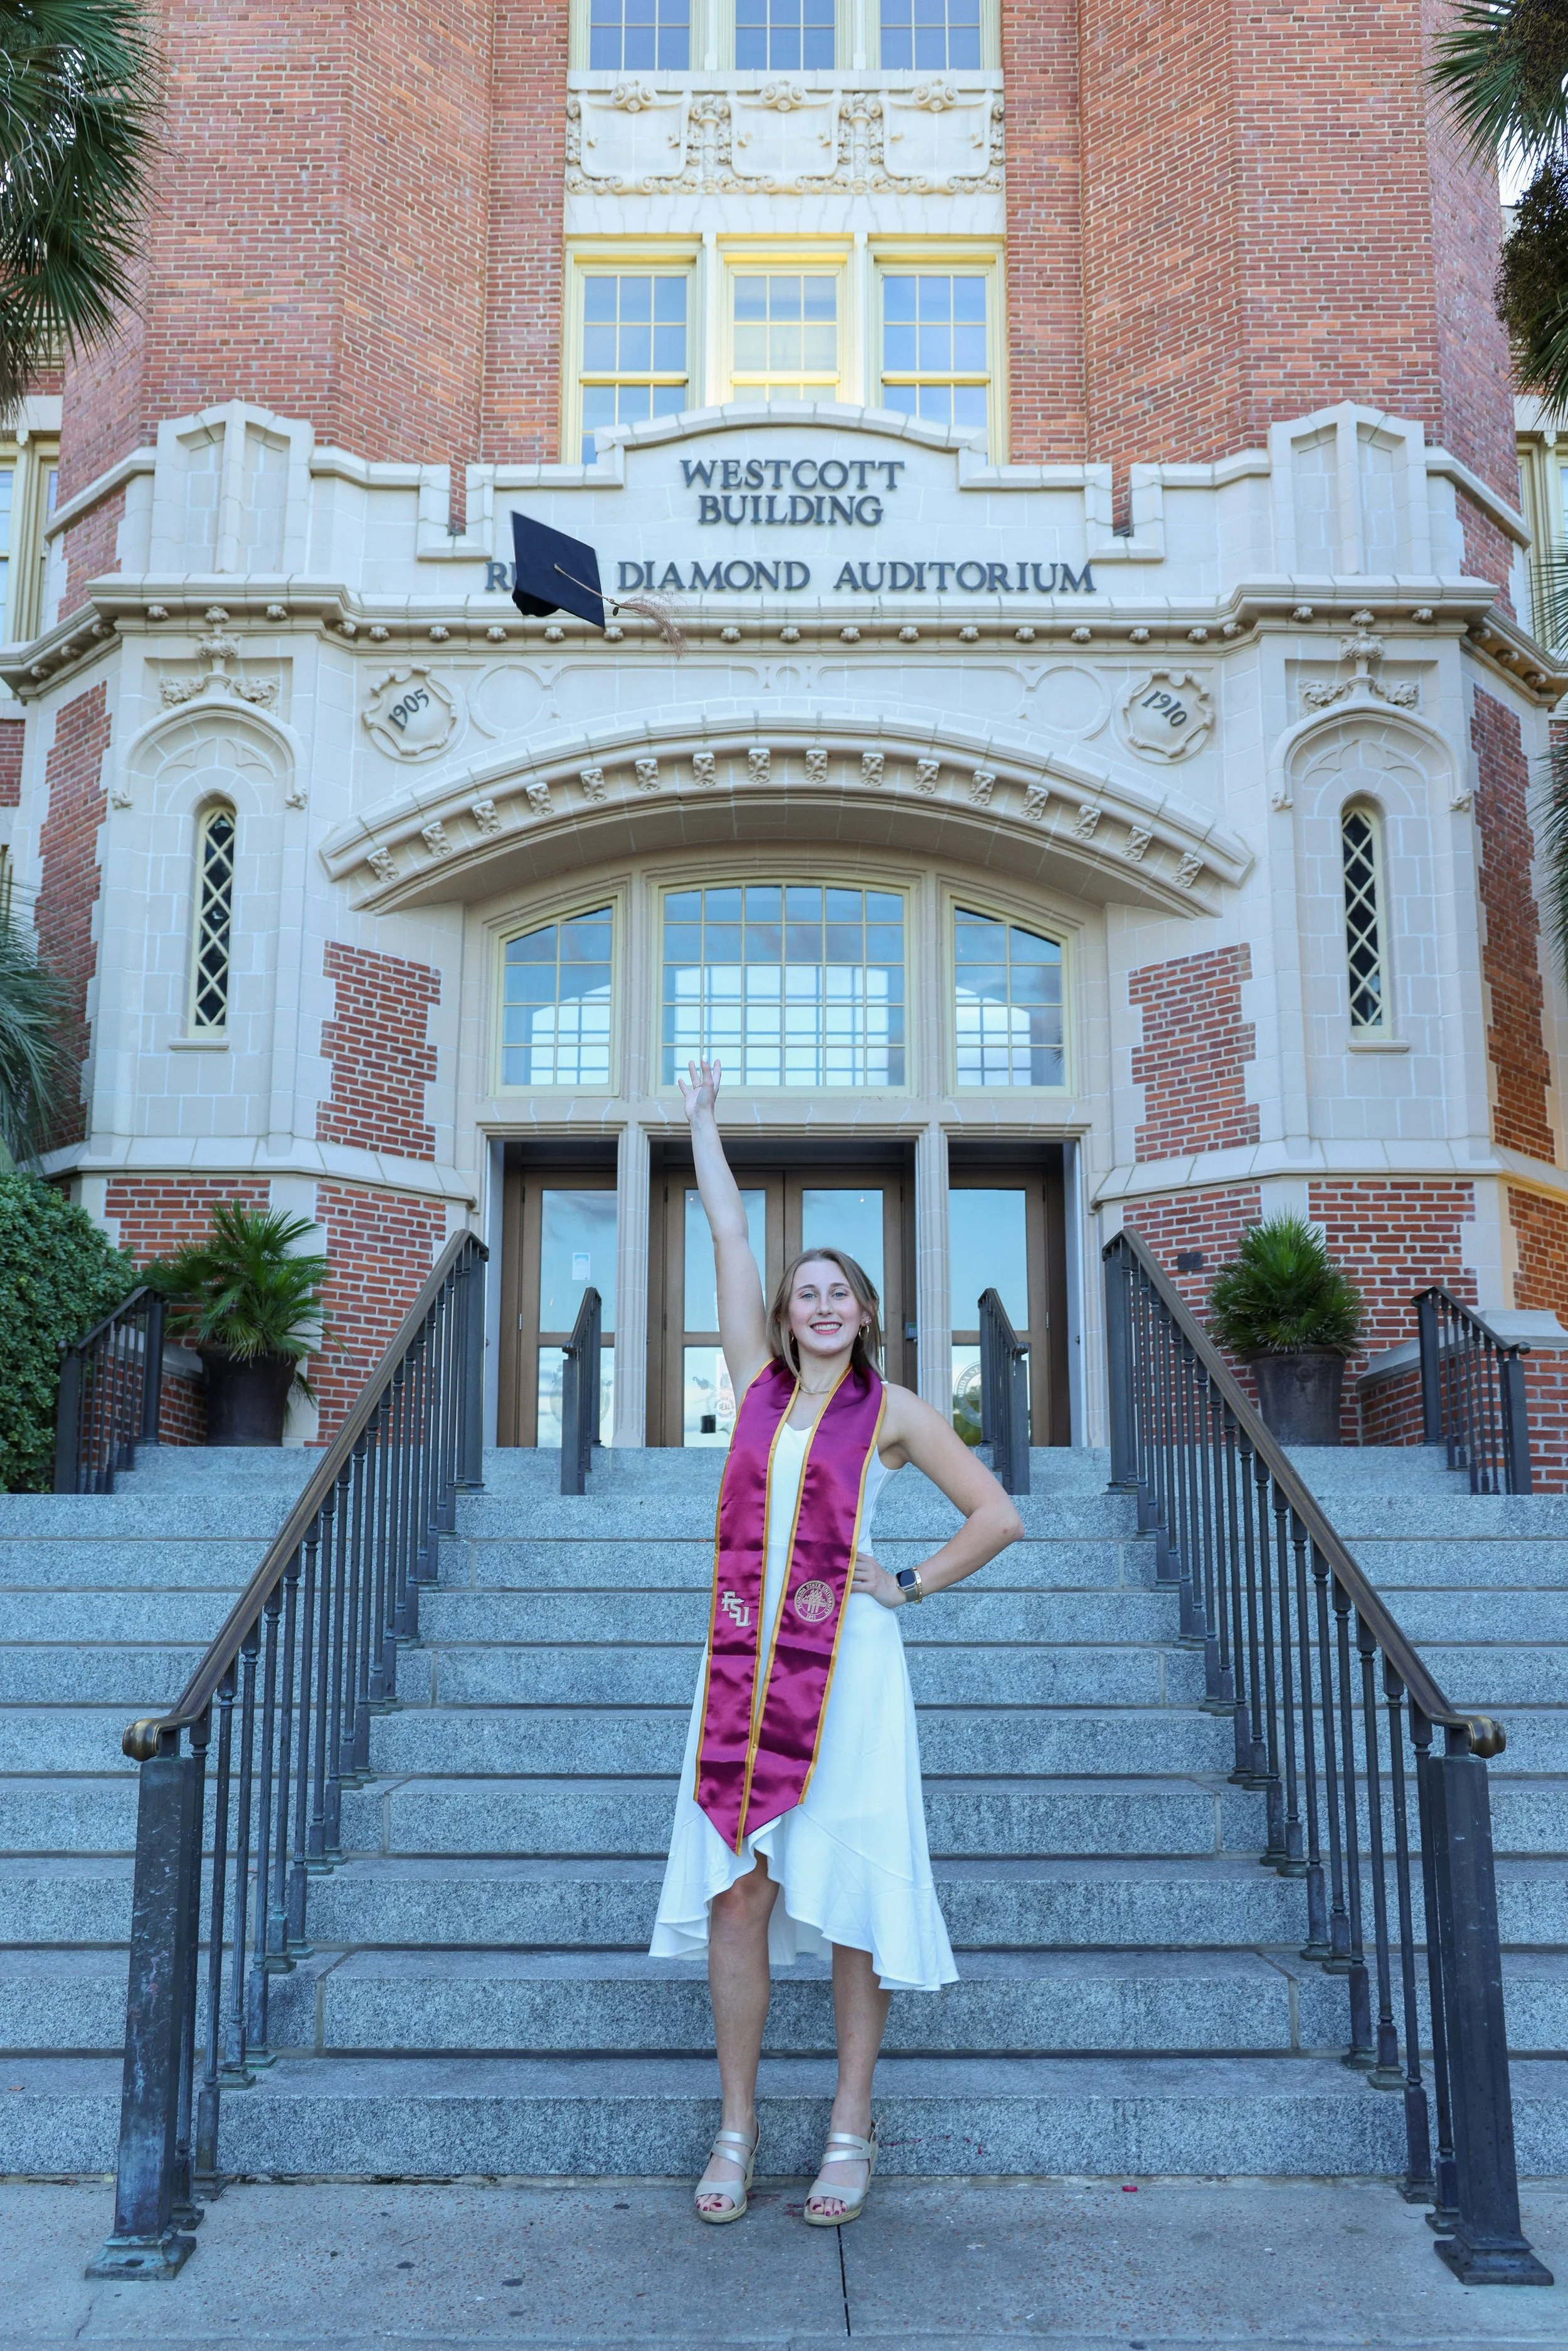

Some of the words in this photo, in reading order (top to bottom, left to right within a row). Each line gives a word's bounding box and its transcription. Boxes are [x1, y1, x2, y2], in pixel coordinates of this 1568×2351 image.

[680, 459, 905, 491] WESTCOTT
[697, 495, 884, 526] BUILDING
[617, 560, 810, 590] DIAMOND
[833, 561, 1098, 592] AUDITORIUM
[388, 687, 430, 732] 1905
[1141, 689, 1187, 727] 1910
[721, 1591, 750, 1627] FSU
